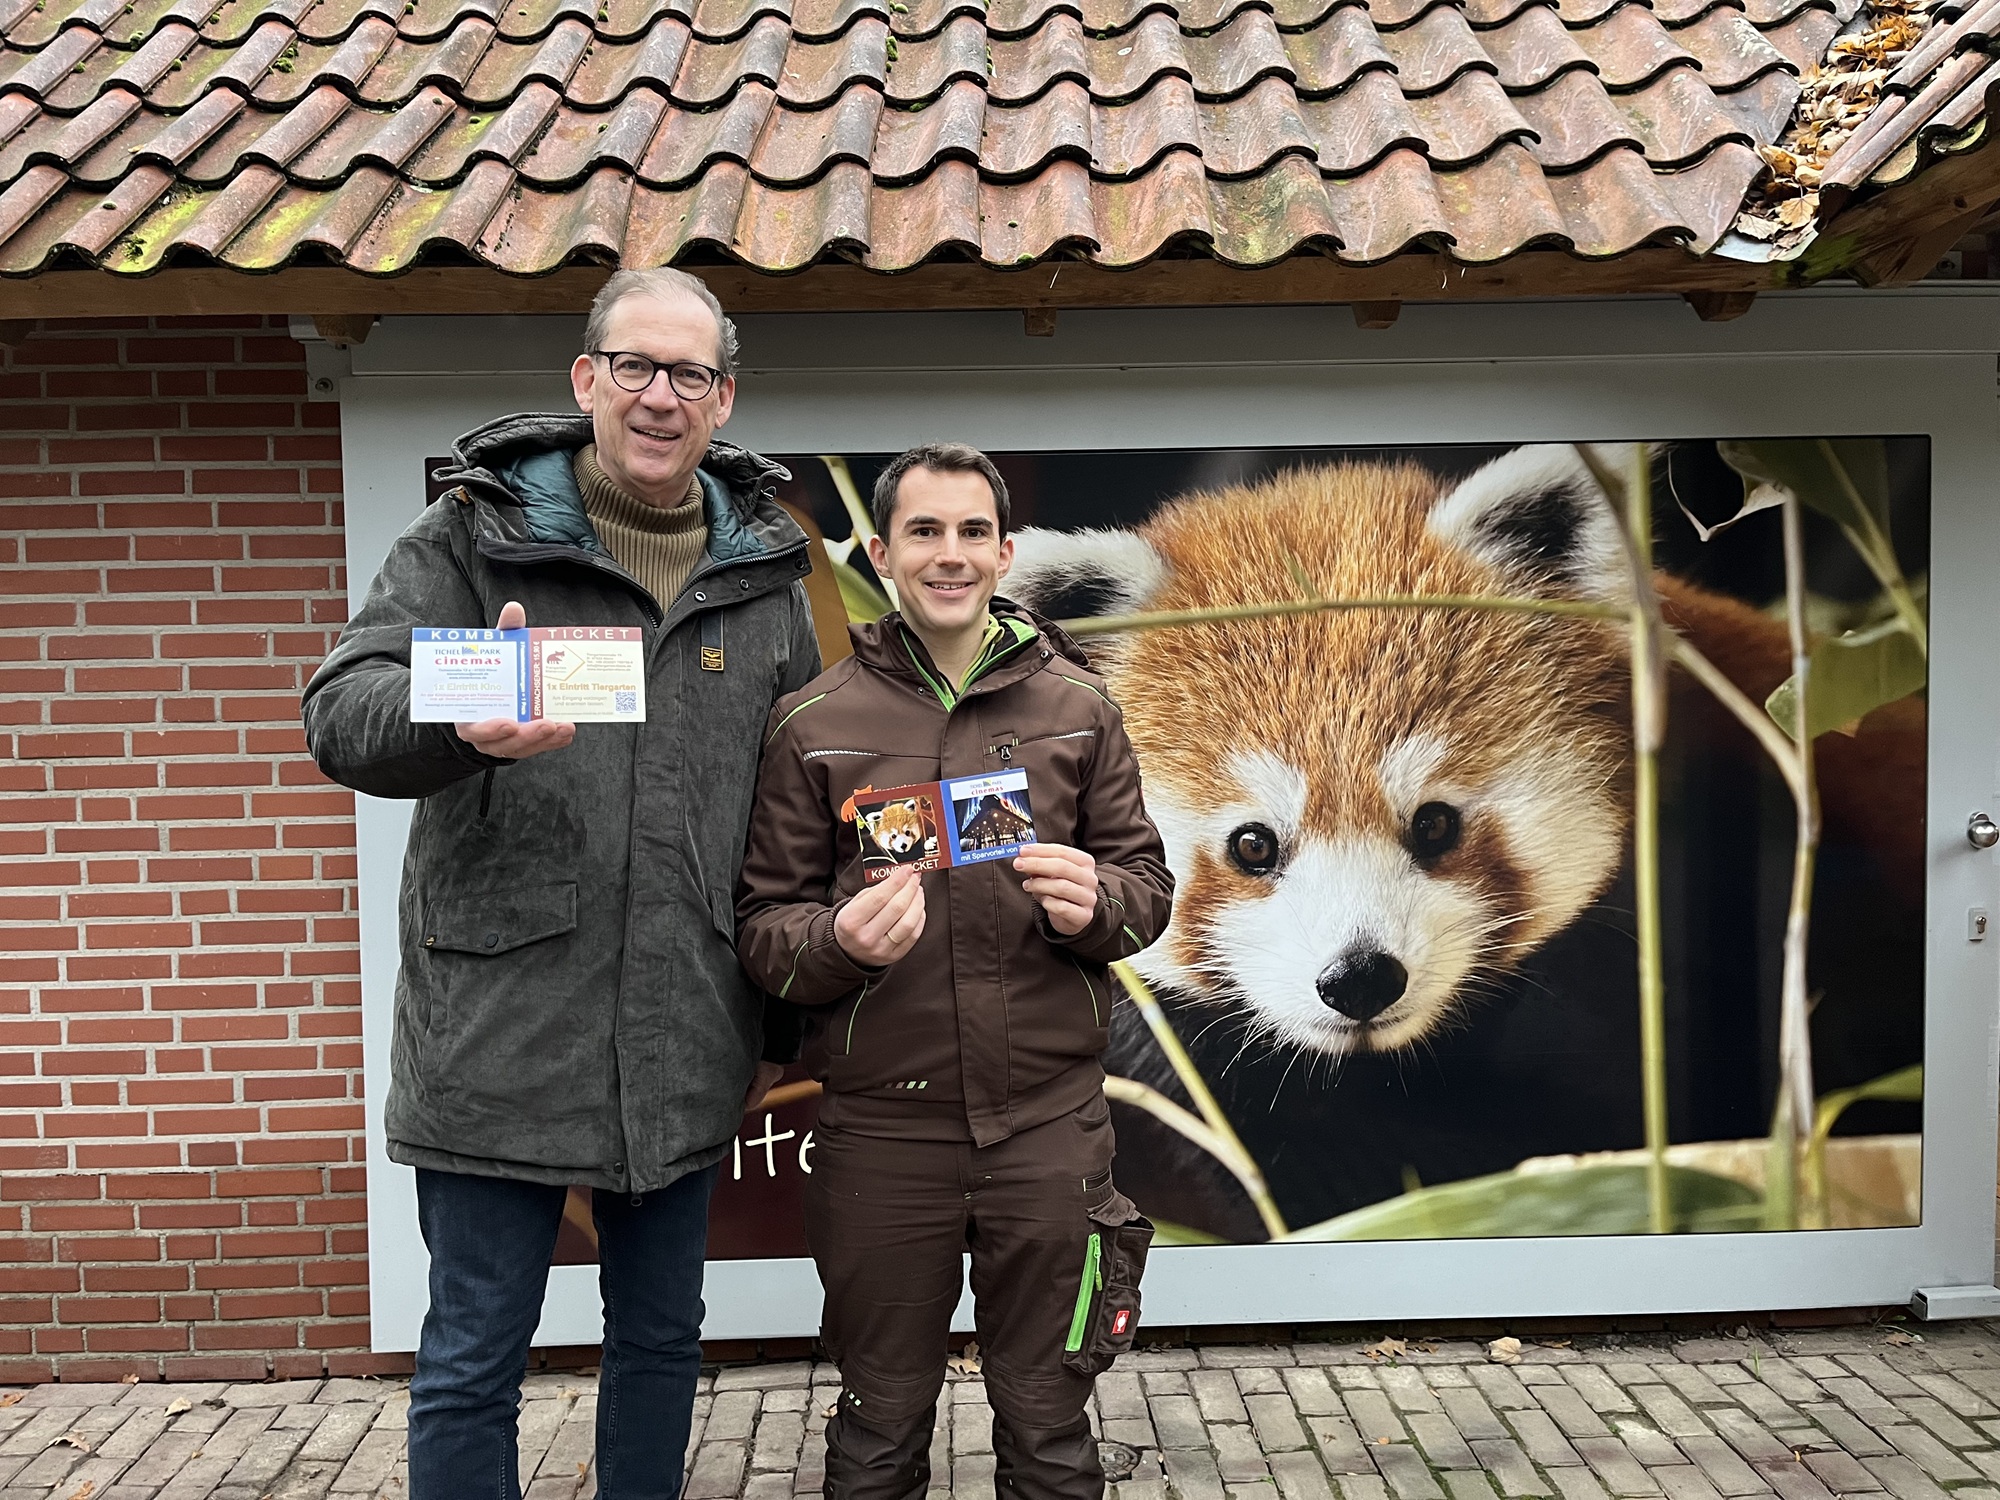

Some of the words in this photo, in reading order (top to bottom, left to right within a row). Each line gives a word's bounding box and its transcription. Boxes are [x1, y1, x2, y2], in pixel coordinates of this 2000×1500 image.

[431, 630, 504, 640] KOMBI
[547, 629, 629, 639] TICKET
[434, 656, 501, 665] cinemas
[434, 683, 445, 691] 1x
[448, 683, 479, 691] Eintritt
[481, 683, 502, 691] Kino
[547, 683, 557, 691] 1x
[560, 683, 590, 691] Eintritt
[592, 683, 636, 692] Tiergarten
[971, 786, 1004, 795] cinemas
[972, 848, 1005, 860] Sparvorteil
